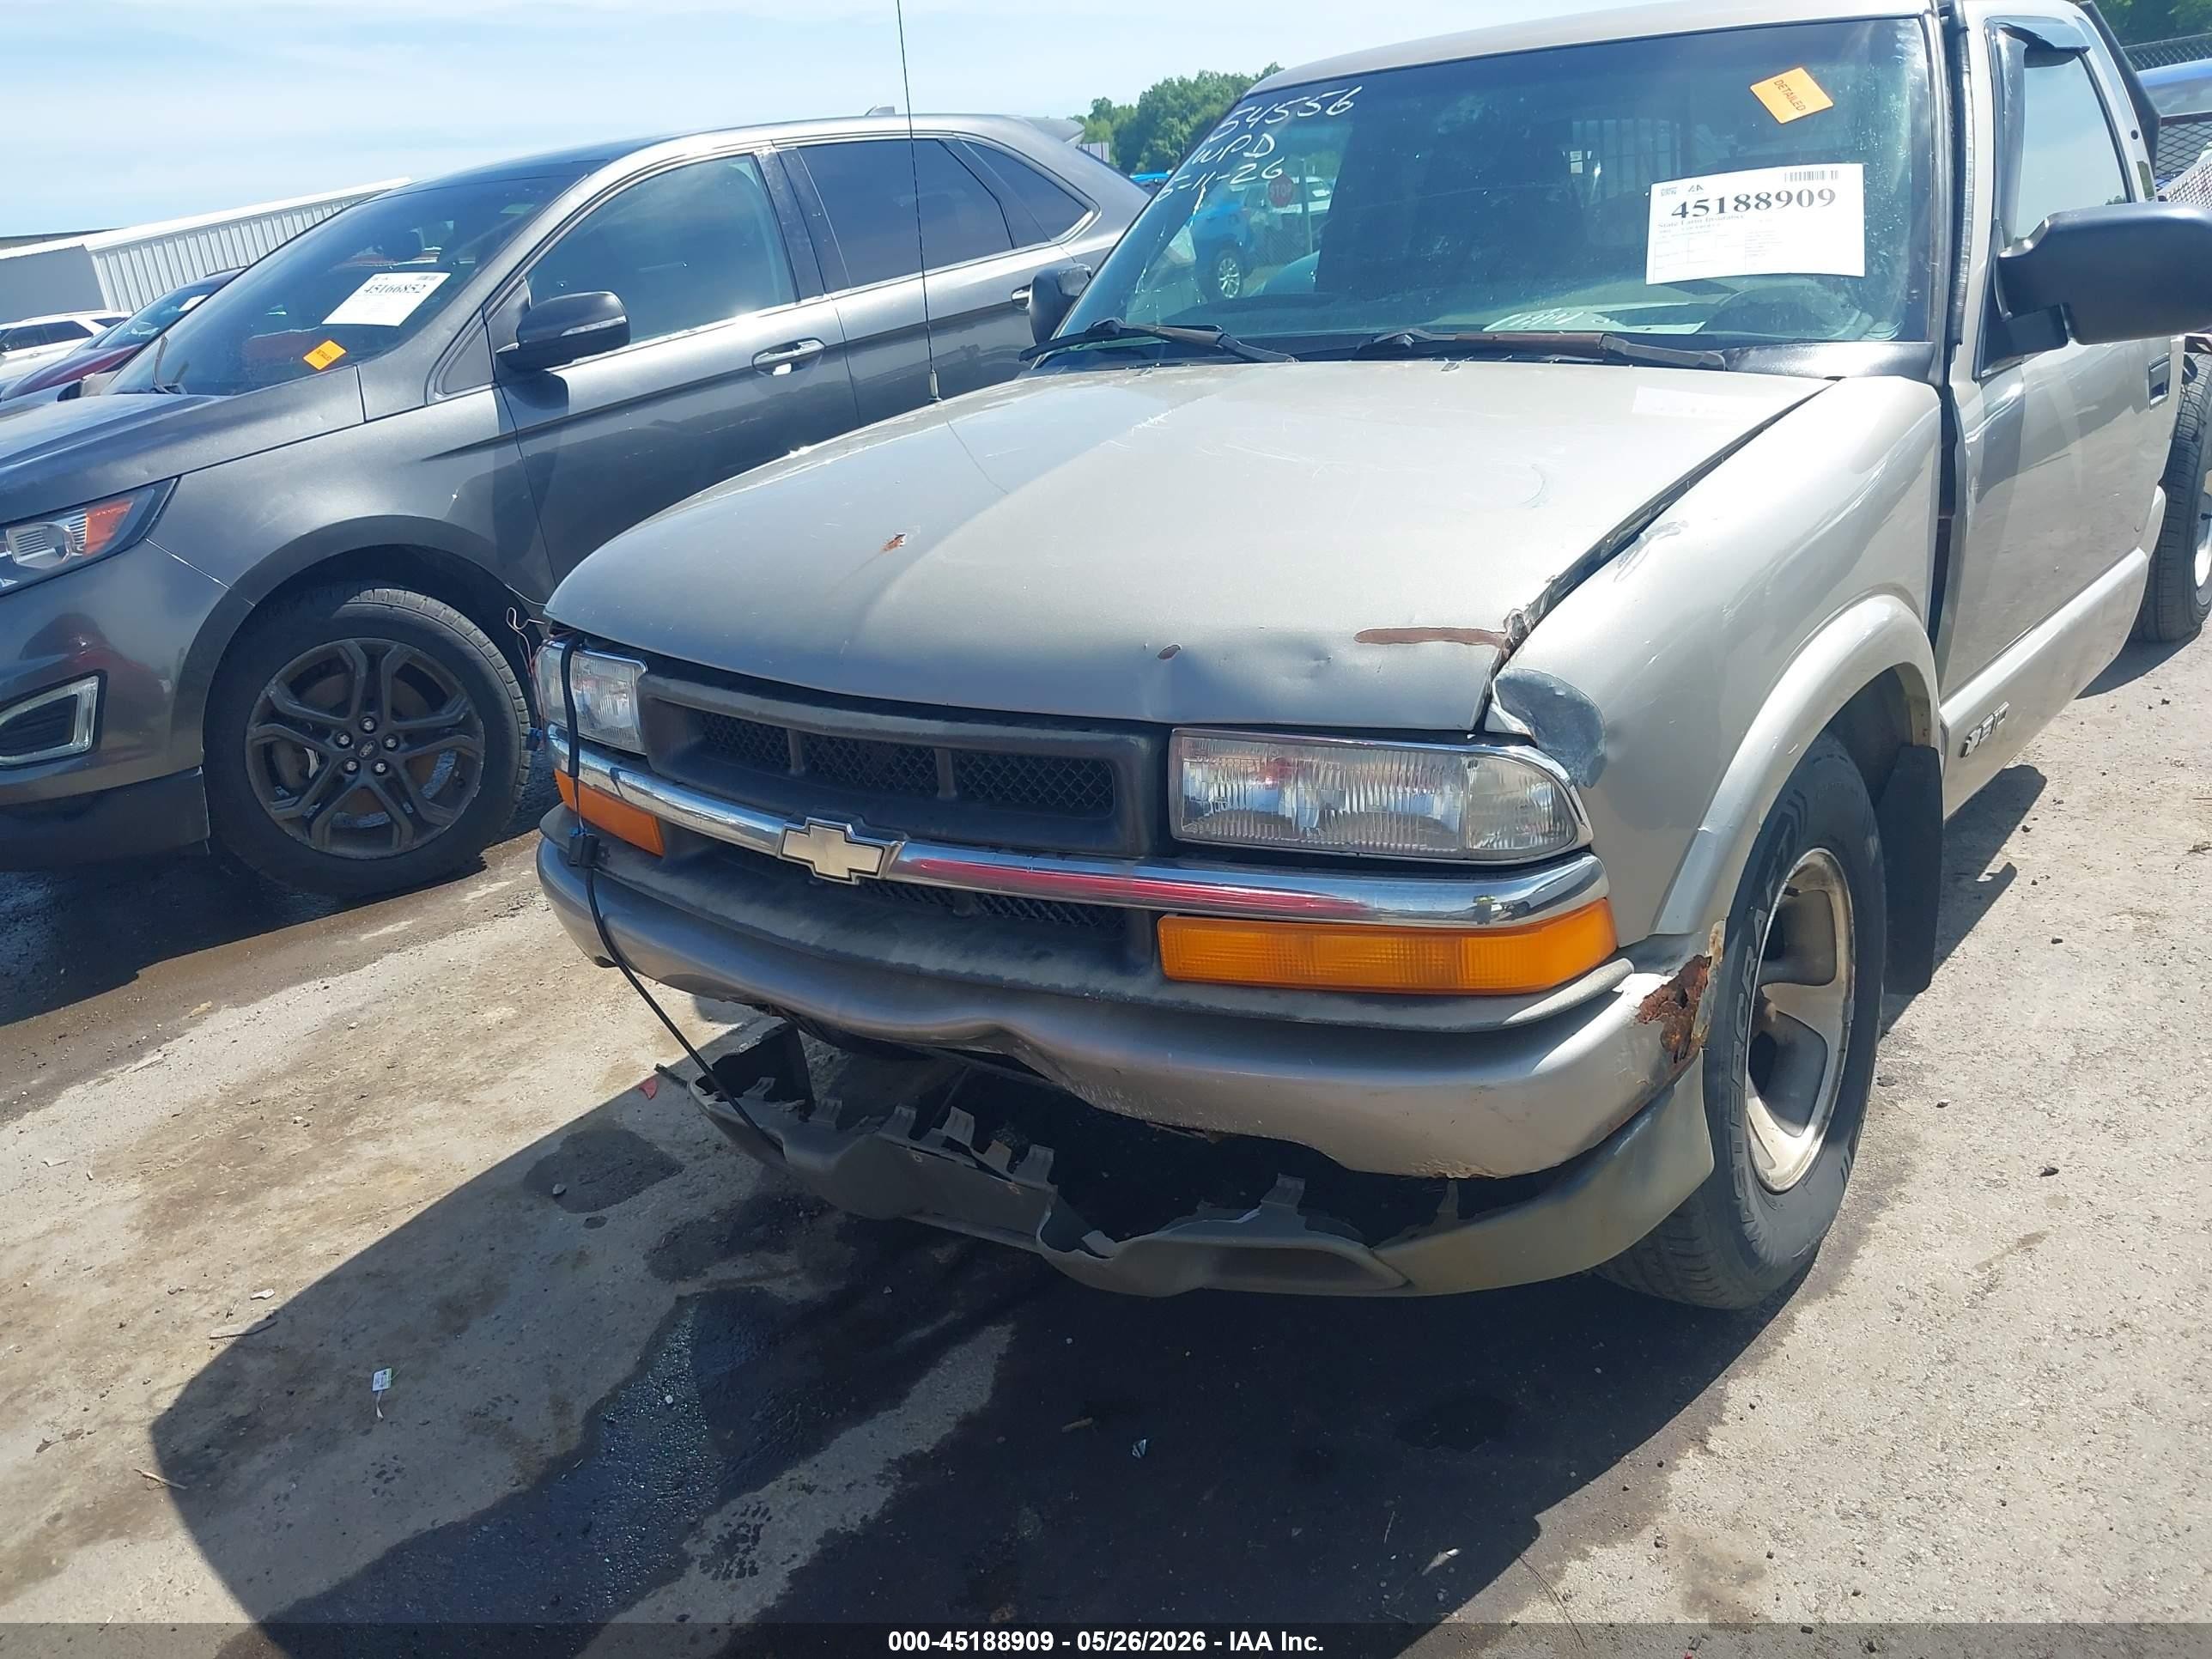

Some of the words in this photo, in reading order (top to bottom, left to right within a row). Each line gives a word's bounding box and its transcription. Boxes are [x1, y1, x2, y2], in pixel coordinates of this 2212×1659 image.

[1774, 79, 1806, 111] DETAILED
[1208, 86, 1363, 143] 54556
[1269, 184, 1291, 198] STOP
[1671, 188, 1836, 218] 45188909
